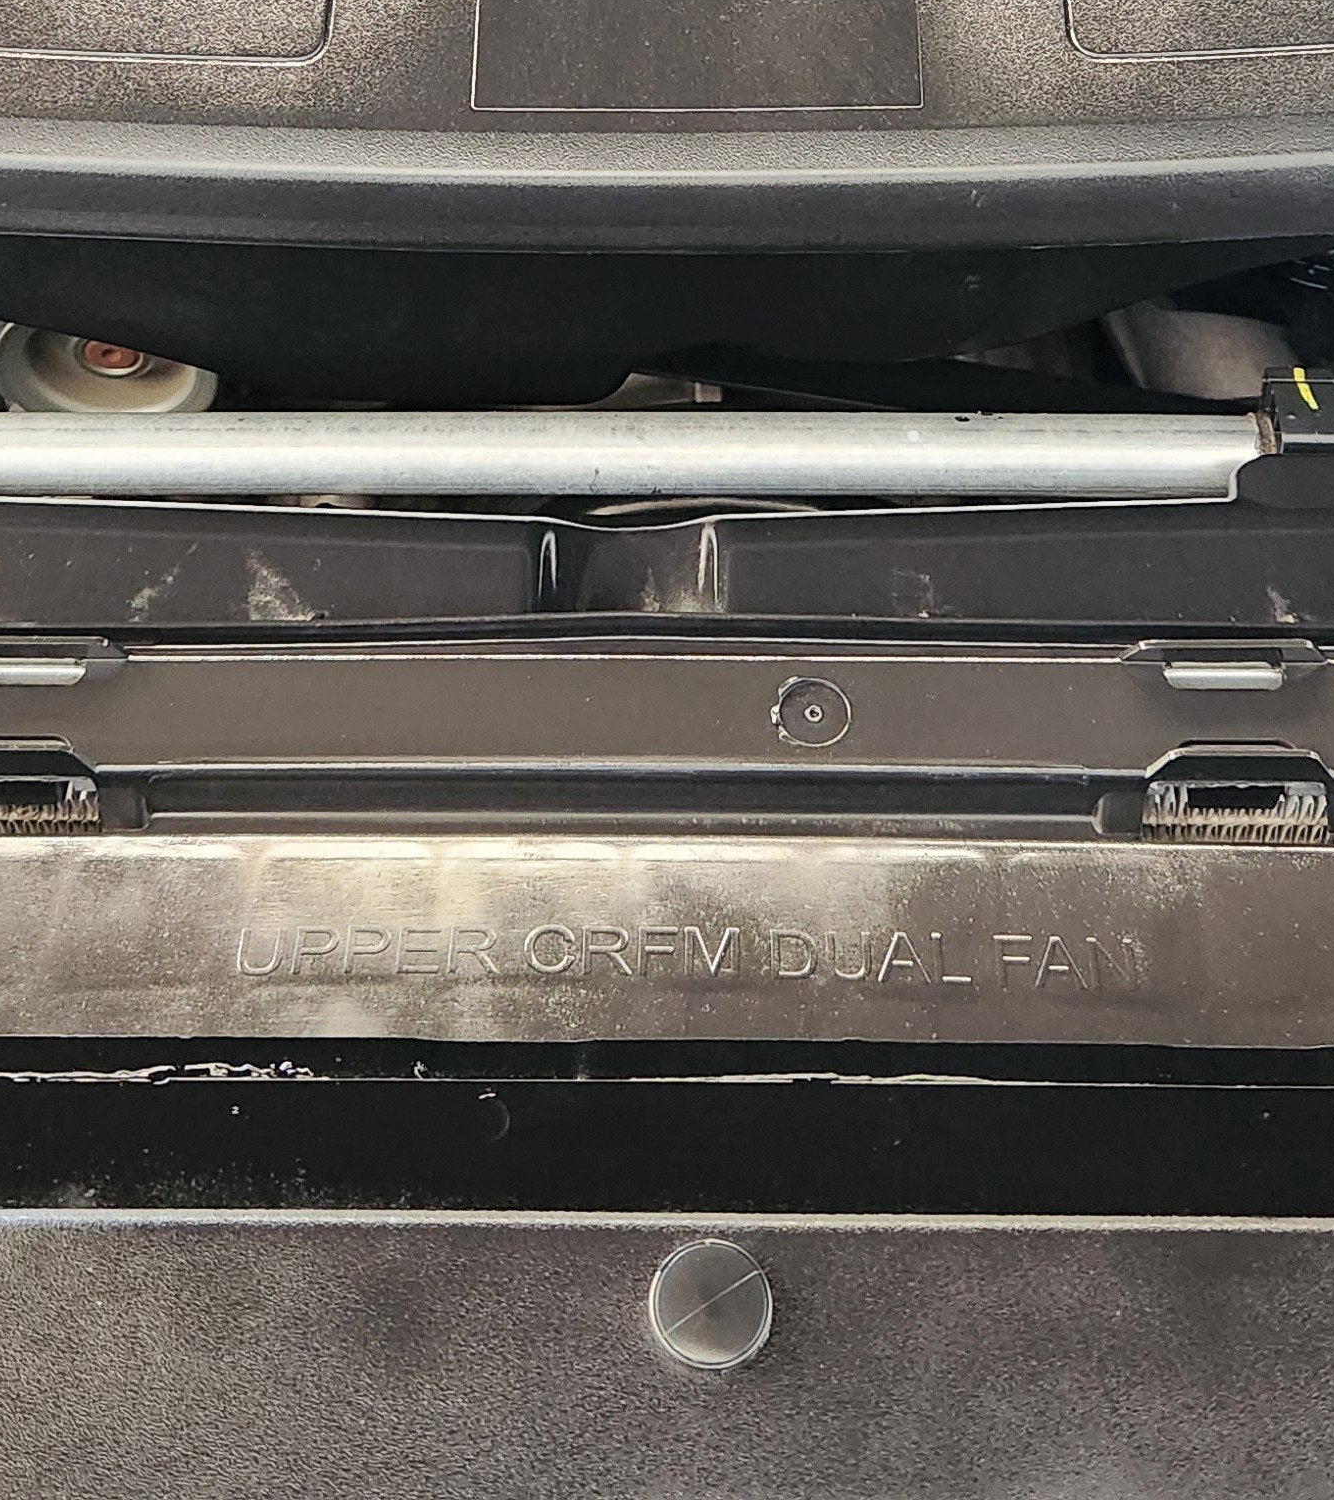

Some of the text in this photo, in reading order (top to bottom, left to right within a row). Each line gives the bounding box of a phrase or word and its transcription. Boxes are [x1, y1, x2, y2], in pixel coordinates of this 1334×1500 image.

[236, 923, 1134, 991] UPPER CRFM DUAL FAN
